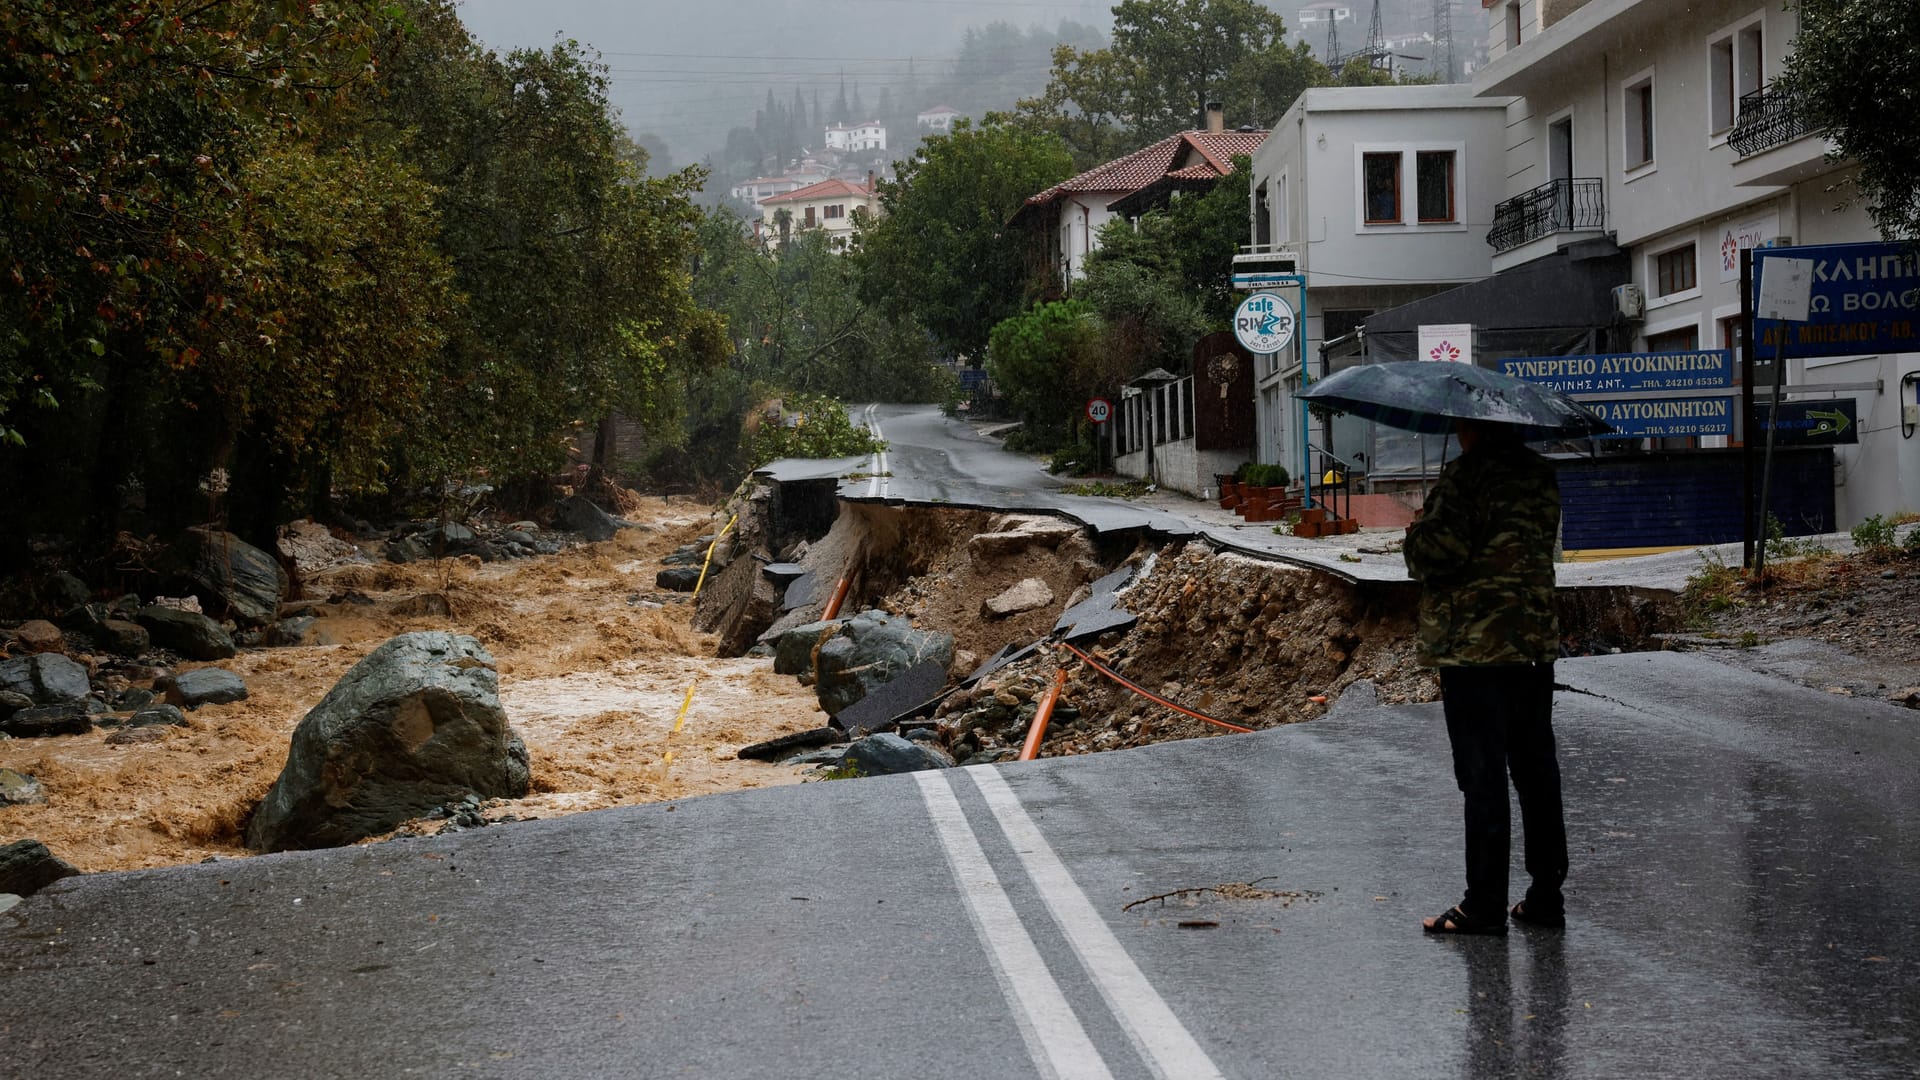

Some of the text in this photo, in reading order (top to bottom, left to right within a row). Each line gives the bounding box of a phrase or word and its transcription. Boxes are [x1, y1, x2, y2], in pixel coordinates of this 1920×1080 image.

[1248, 298, 1273, 313] cafe
[1504, 353, 1723, 377] ΣΥΝΕΡΓΕΙΟ ΑΥΤΟΚΙΝΗΤΩΝ
[1597, 379, 1625, 390] ΑΝΤ.
[1665, 378, 1693, 387] 24210
[1695, 376, 1724, 386] 45358
[1092, 405, 1106, 415] 40
[1612, 400, 1726, 420] ΑΥΤΟΚΙΝΗΤΩΝ
[1668, 425, 1697, 434] 24210
[1699, 424, 1727, 433] 56217
